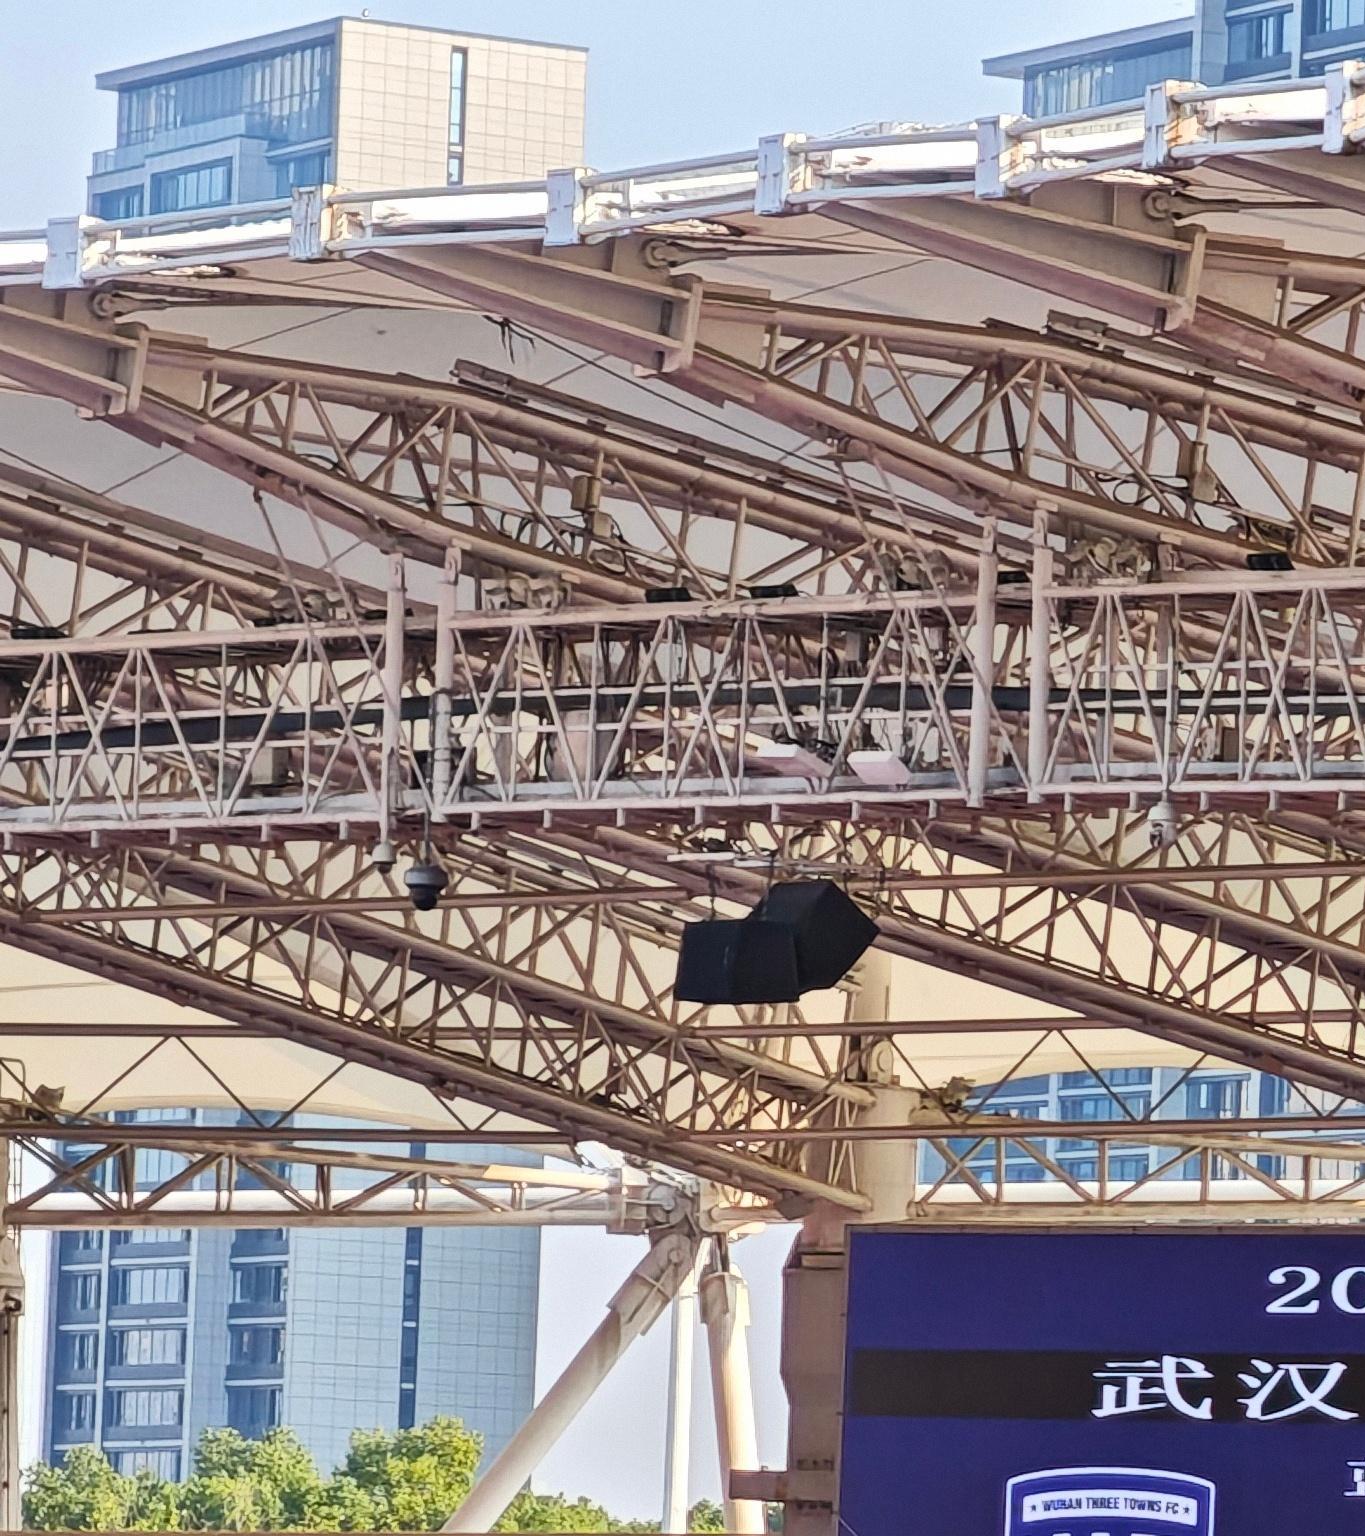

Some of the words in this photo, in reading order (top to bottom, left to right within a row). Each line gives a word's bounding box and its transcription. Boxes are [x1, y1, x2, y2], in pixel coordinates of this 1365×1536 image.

[1042, 1497, 1082, 1512] WUHAN
[1086, 1496, 1120, 1510] THREE
[1124, 1497, 1162, 1513] TOWNS
[1165, 1501, 1180, 1515] FC
